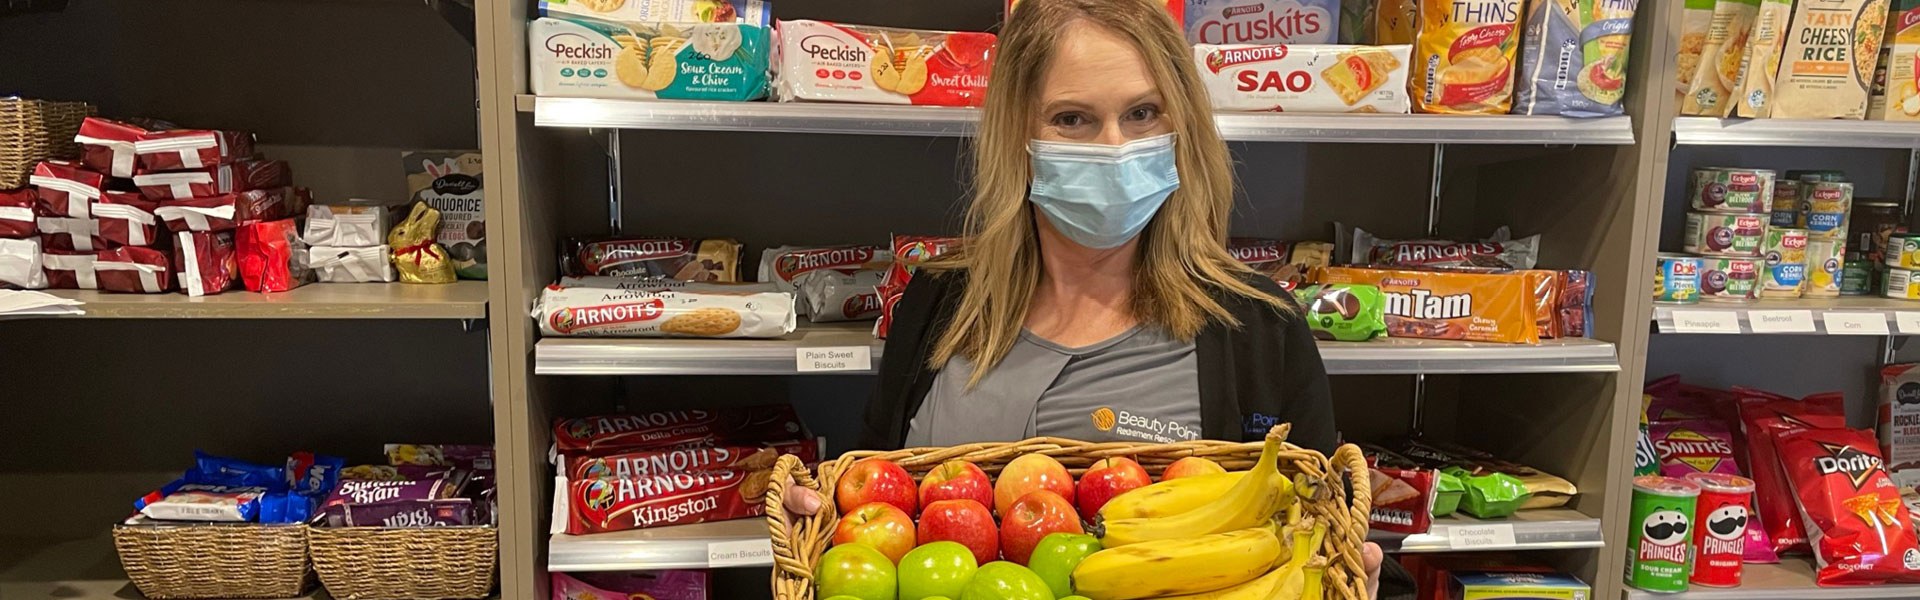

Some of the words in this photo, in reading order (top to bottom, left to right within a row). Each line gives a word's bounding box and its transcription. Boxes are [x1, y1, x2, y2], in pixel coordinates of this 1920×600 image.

[1452, 1, 1518, 23] THINS
[1807, 12, 1852, 25] TASTY
[1199, 8, 1320, 45] Cruskits
[1459, 34, 1479, 48] Tasty
[1479, 28, 1506, 39] Cheese
[1800, 27, 1852, 46] CHEESY
[555, 42, 612, 59] Peckish
[811, 44, 866, 62] Peckish
[1224, 46, 1284, 64] ARNOTT'S
[1802, 47, 1847, 61] RICE
[681, 61, 706, 75] Sour
[708, 62, 743, 75] Cream
[692, 75, 700, 85] &
[701, 73, 729, 86] Chive
[931, 72, 960, 87] Sweet
[961, 74, 989, 88] Chilli
[1237, 70, 1312, 93] SAO
[425, 198, 482, 212] IQUORICE
[1812, 214, 1838, 222] CORN
[605, 240, 684, 260] ARNOTT'S
[1228, 245, 1280, 260] NOTT'S
[798, 249, 867, 269] ARNOTT'S
[610, 266, 647, 277] Chocolate
[615, 281, 686, 289] Arrowroot
[601, 292, 676, 301] Arrowroot
[1385, 289, 1471, 319] mTam
[575, 302, 657, 325] ARNOTT'S
[1762, 314, 1793, 322] Beetroot
[1469, 323, 1499, 332] Caramel
[1472, 316, 1496, 326] Chewy
[1684, 320, 1720, 330] Pineapple
[1844, 321, 1861, 329] Corn
[805, 351, 827, 359] Plain
[828, 350, 854, 359] Sweet
[814, 361, 846, 369] Biscuits
[1118, 411, 1167, 434] Beauty
[1168, 421, 1199, 441] Point
[1655, 439, 1732, 459] SMITH'S
[351, 486, 403, 504] Bran
[632, 495, 718, 527] Kingston
[1459, 528, 1495, 537] Chocolate
[1640, 539, 1686, 563] PRINGLES
[1703, 535, 1745, 555] PRINGLES
[710, 552, 738, 560] Cream
[740, 549, 771, 558] Biscuits
[1641, 564, 1659, 573] SOUR
[1660, 565, 1683, 573] CREAM
[1709, 559, 1739, 567] ORIGINAL
